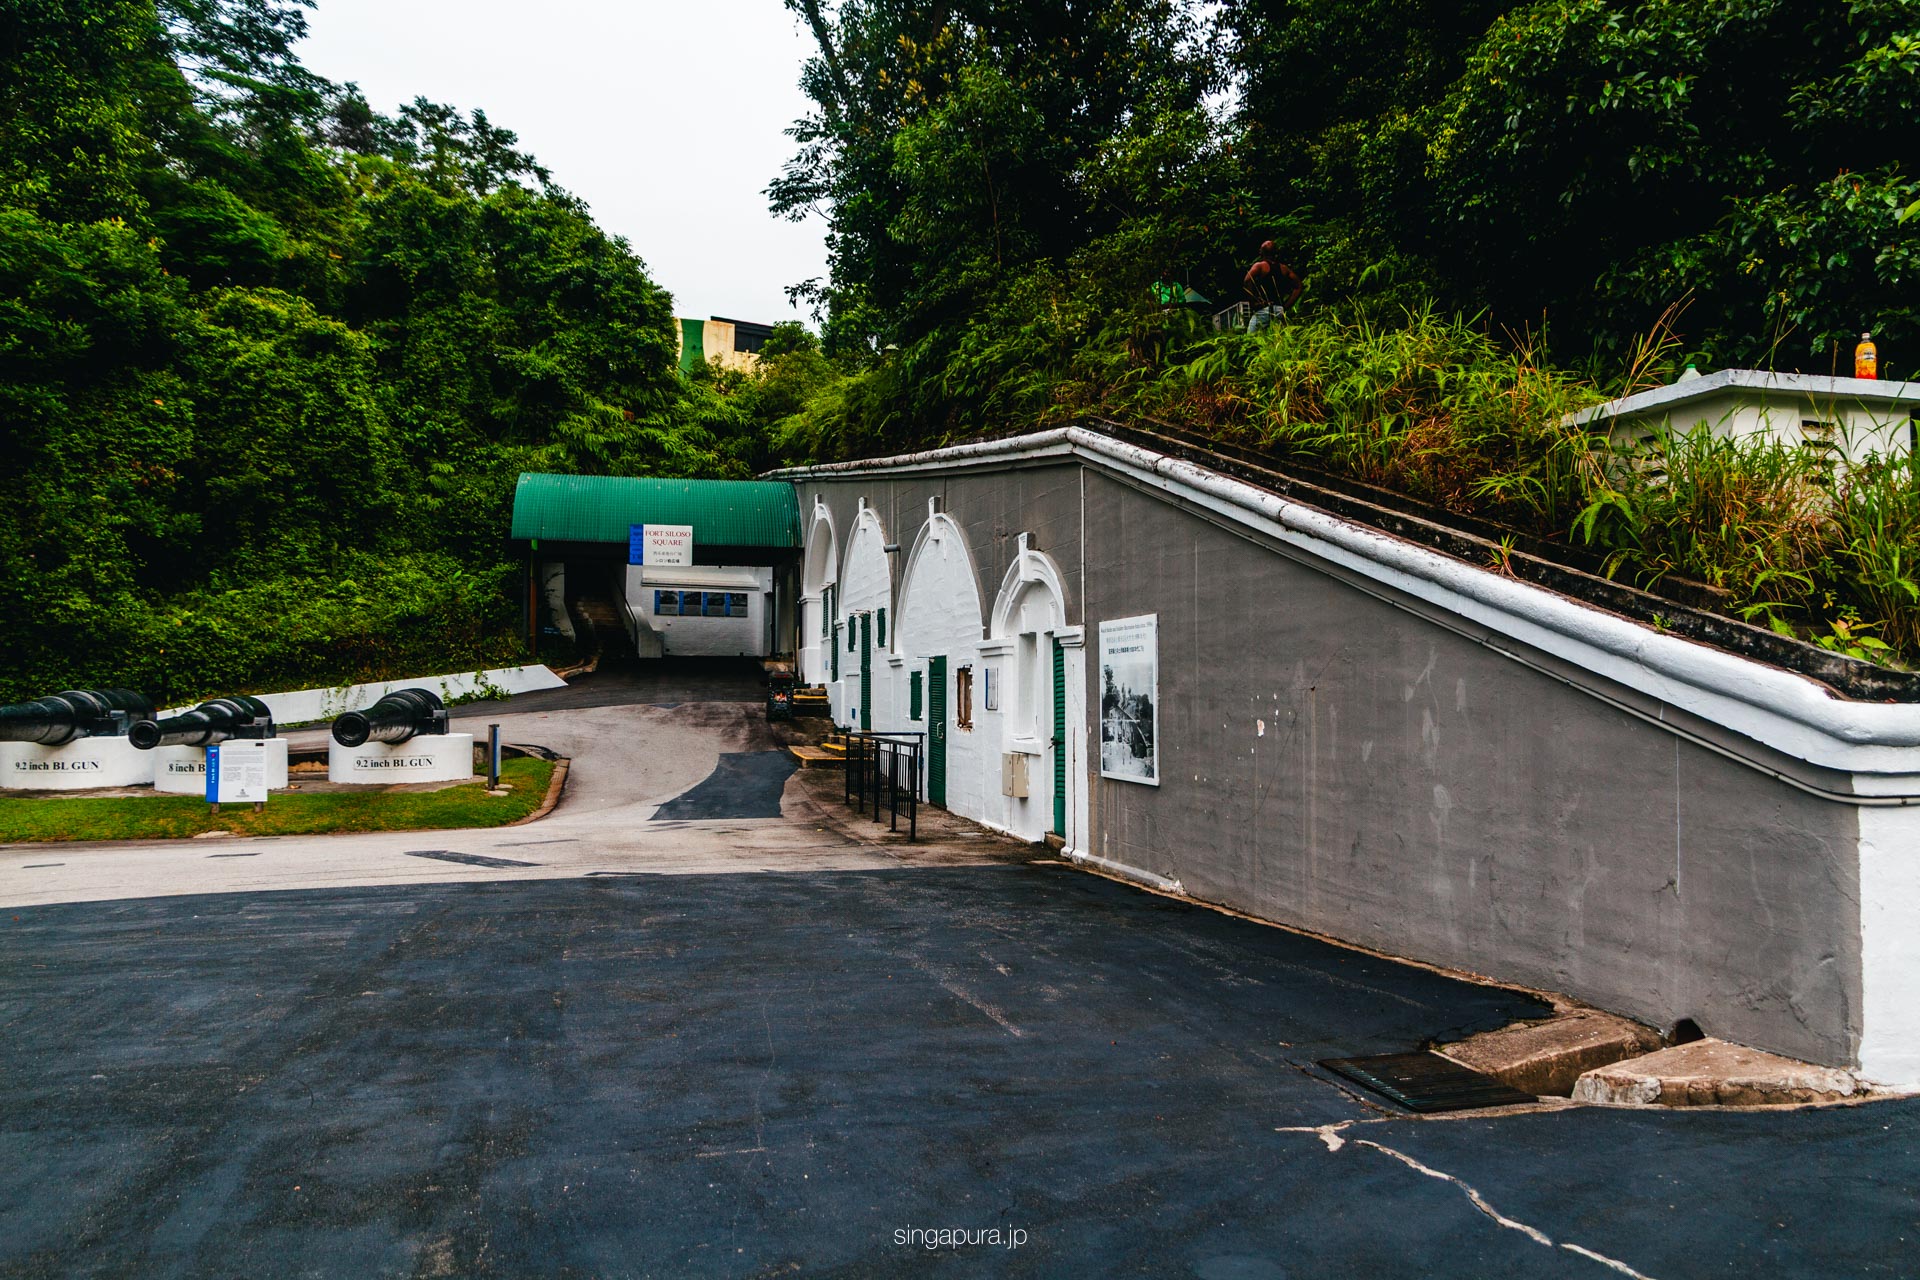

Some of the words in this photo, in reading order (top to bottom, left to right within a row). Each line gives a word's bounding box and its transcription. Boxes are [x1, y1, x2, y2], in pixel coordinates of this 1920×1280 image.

[15, 761, 27, 770] 9.2
[29, 761, 49, 770] inch
[53, 761, 69, 770] BL
[71, 761, 99, 770] GUN
[393, 759, 407, 767] BL
[409, 758, 433, 767] GUN
[168, 763, 174, 772] 8
[175, 763, 195, 772] inch
